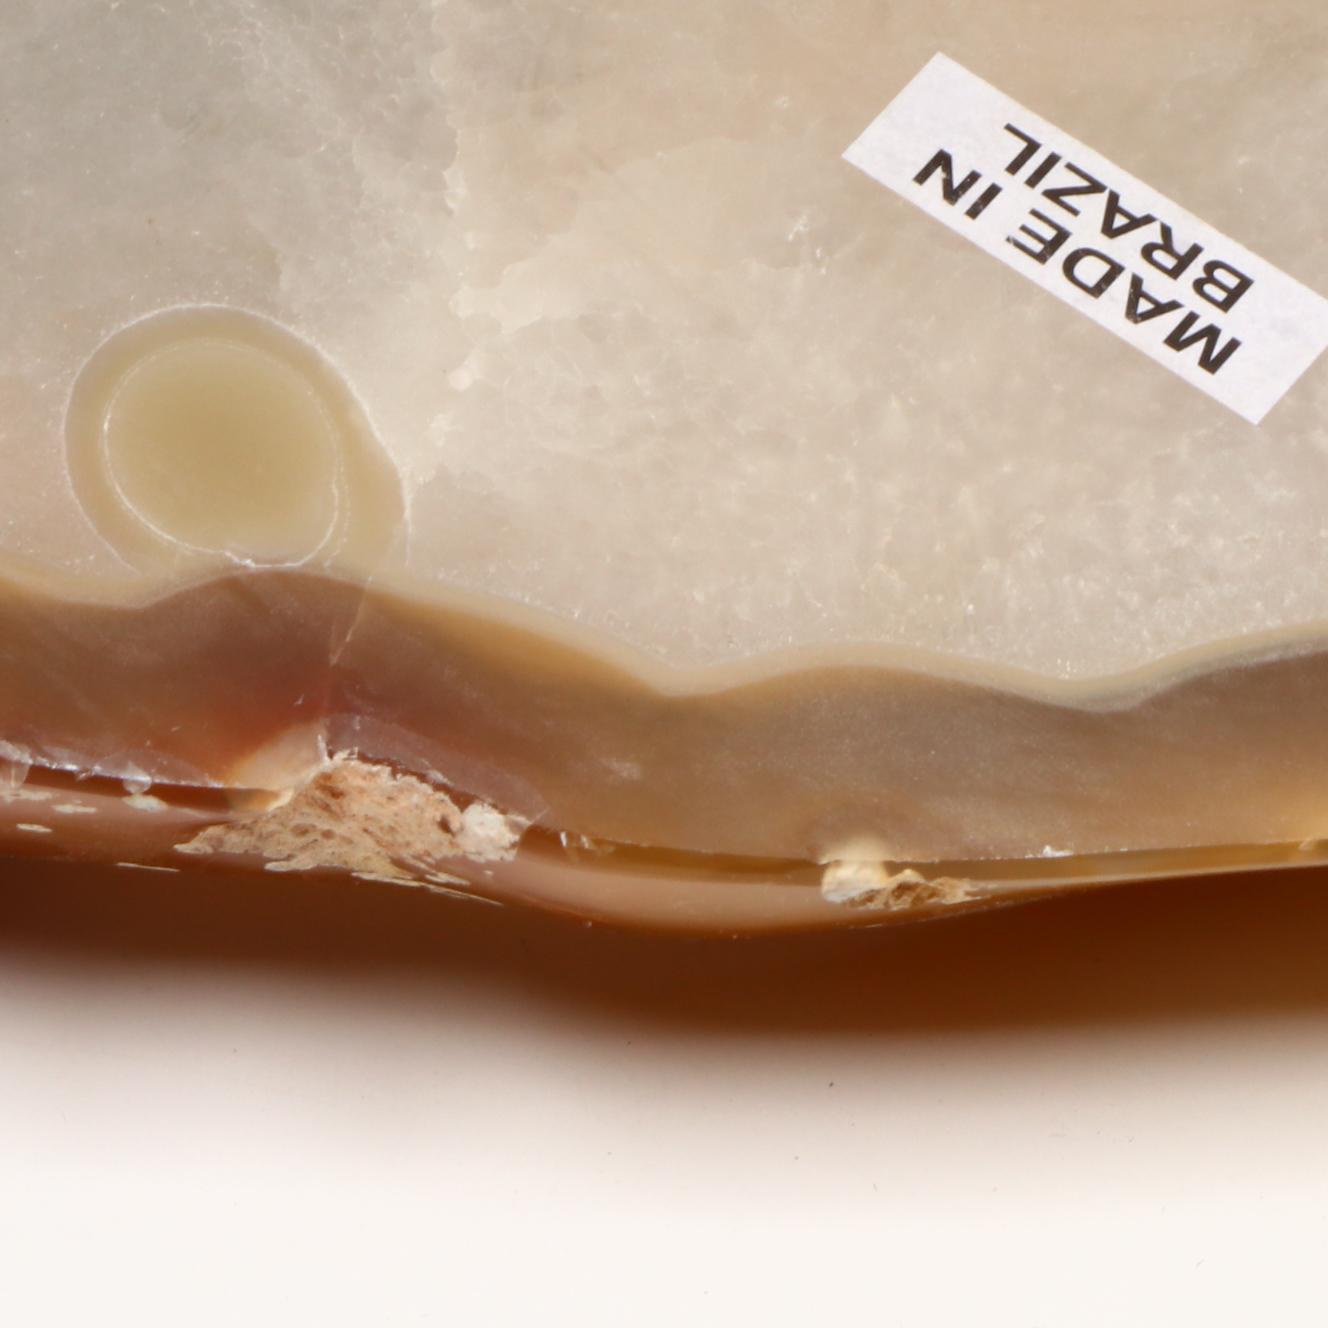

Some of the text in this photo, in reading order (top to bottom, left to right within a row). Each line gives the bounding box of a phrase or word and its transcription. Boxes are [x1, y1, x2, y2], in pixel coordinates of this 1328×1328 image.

[912, 149, 1242, 375] MADE IN
[1003, 122, 1255, 314] BRAZIL
